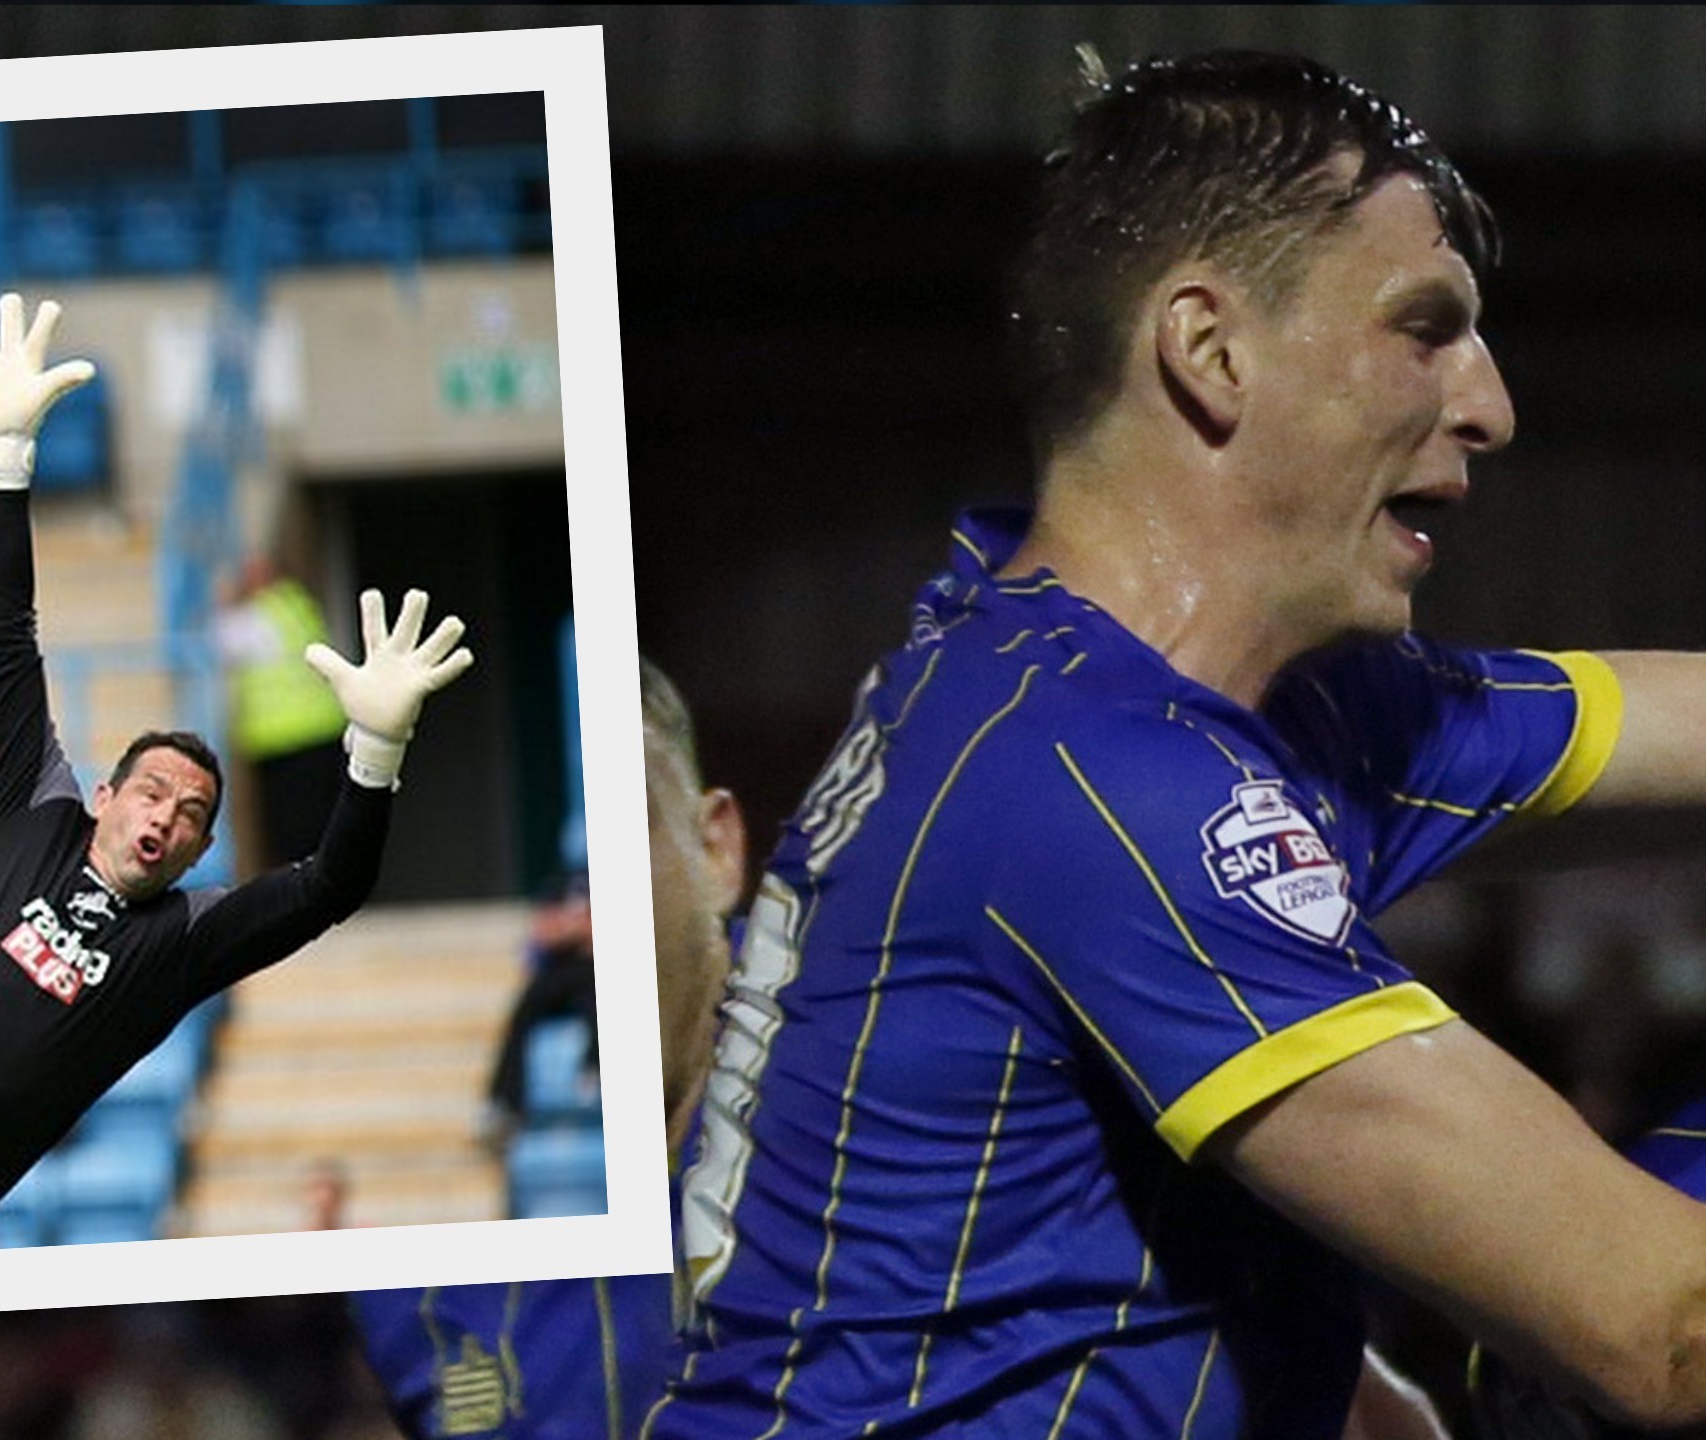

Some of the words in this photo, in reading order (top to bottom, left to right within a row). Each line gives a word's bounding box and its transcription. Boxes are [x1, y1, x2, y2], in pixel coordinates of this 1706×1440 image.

[1219, 842, 1279, 883] sky
[3, 922, 79, 999] PLUS
[20, 897, 111, 986] racing
